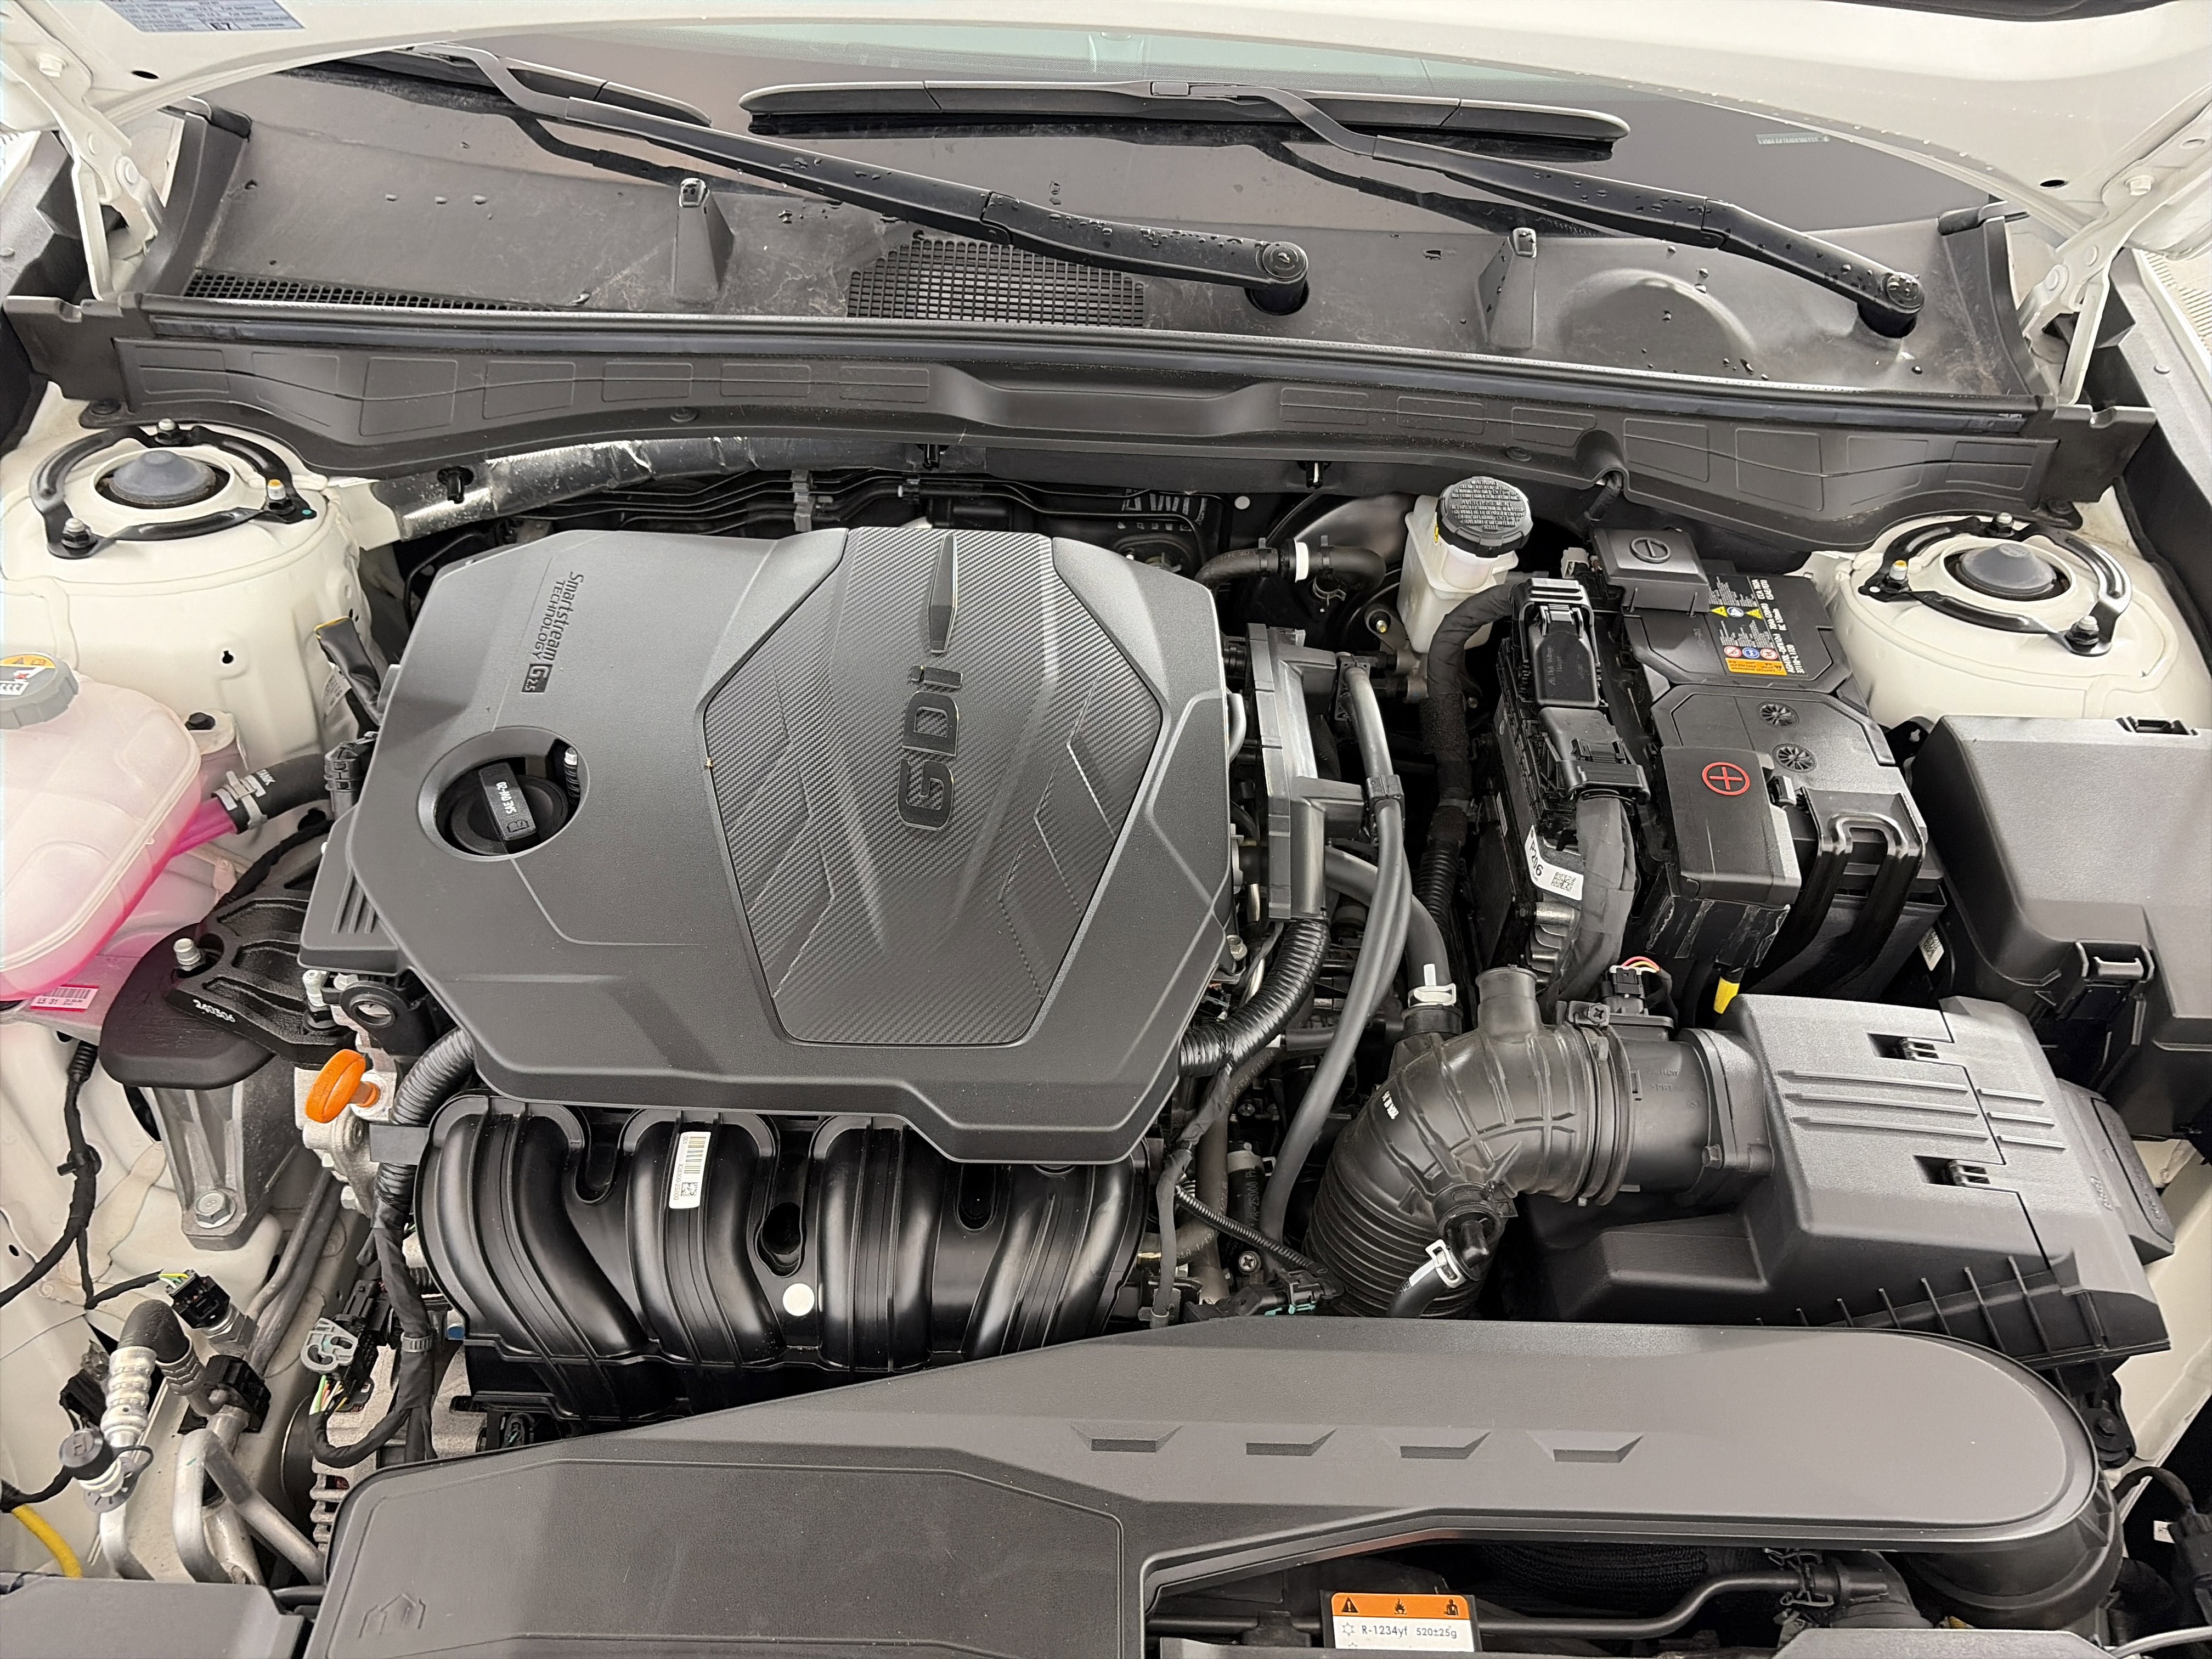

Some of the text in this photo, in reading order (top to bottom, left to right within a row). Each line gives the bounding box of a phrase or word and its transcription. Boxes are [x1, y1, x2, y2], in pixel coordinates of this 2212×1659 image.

[532, 580, 566, 660] TECHNOLOGY
[543, 571, 584, 662] Smartstream
[255, 769, 276, 786] TANK
[496, 781, 517, 814] SAE 0W-20
[1529, 839, 1544, 876] P206
[1361, 1625, 1457, 1639] R-1234yf 520±25g
